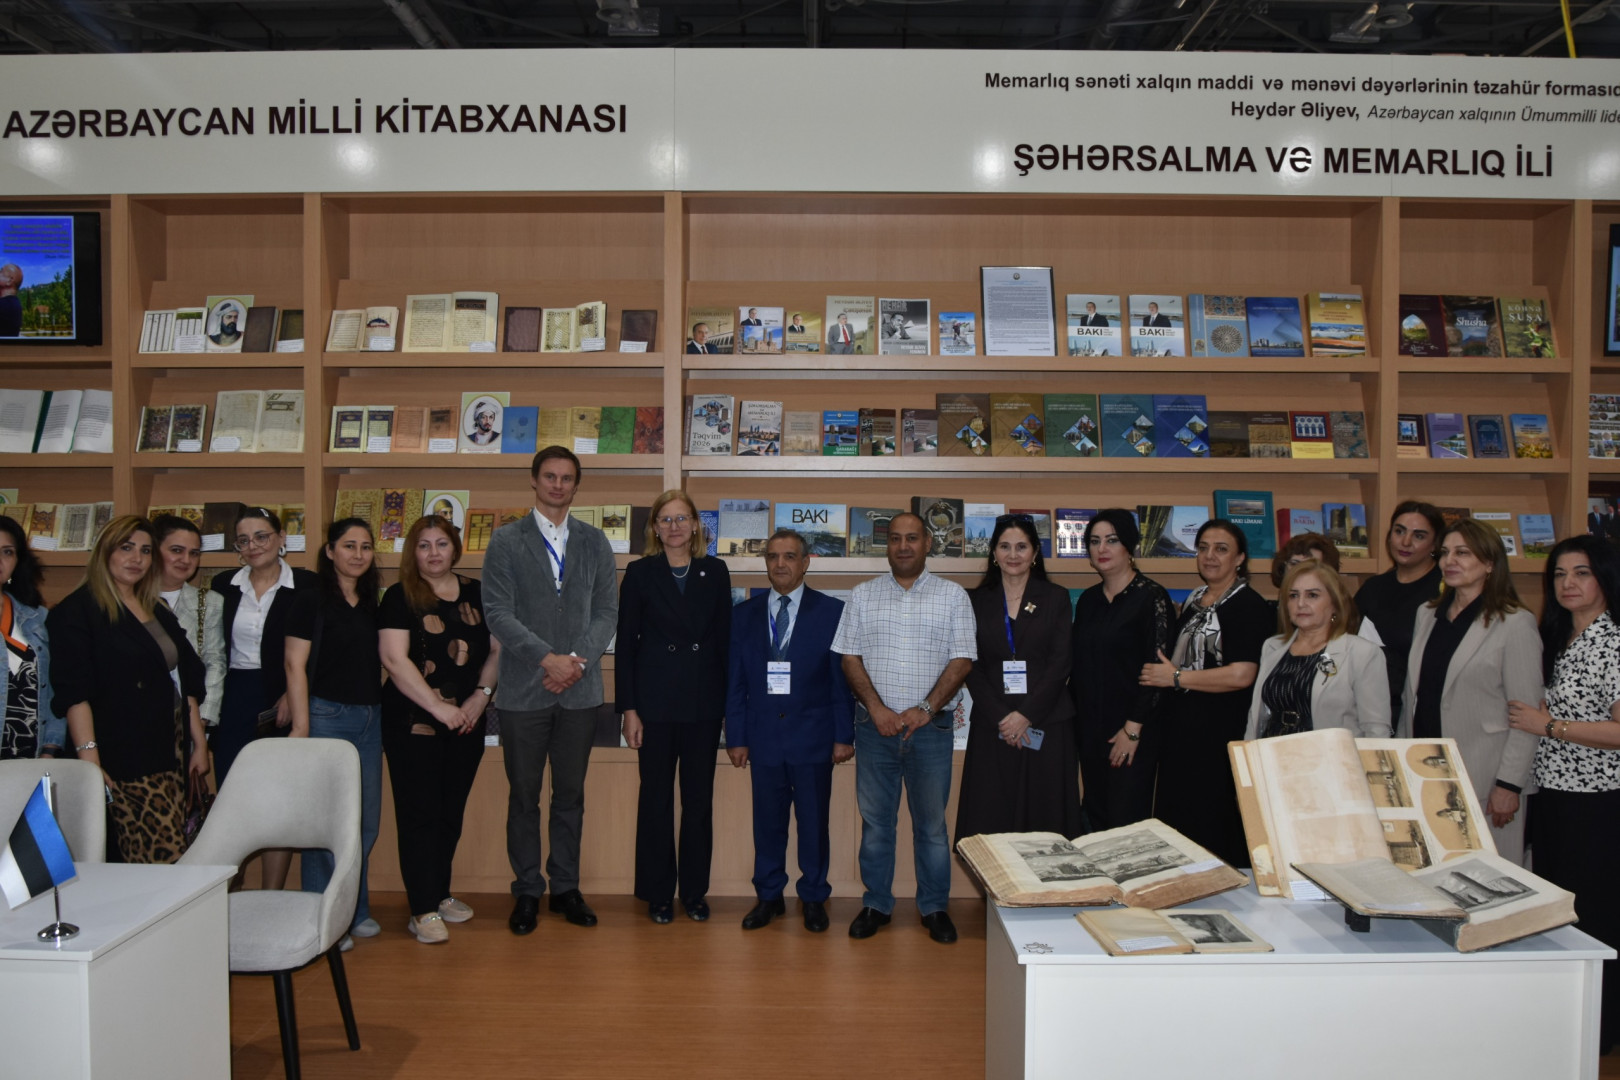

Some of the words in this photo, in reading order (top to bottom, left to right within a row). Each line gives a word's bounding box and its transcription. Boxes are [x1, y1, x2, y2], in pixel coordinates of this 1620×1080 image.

[985, 72, 1069, 92] Memarlıq
[1075, 74, 1130, 89] sənəti
[1136, 74, 1191, 93] xalqın
[1198, 75, 1254, 90] maddi
[1262, 79, 1284, 90] və
[1291, 76, 1356, 93] mənəvi
[1361, 77, 1469, 97] dəyərlərinin
[1473, 79, 1541, 96] təzahür
[2, 106, 255, 139] AZƏRBAYCAN
[268, 97, 362, 135] MİLLİ
[375, 97, 627, 134] KİTABXANASI
[1231, 101, 1297, 120] Heydər
[1301, 102, 1360, 122] Əliyev,
[1366, 105, 1455, 123] Azərbaycan
[1458, 107, 1517, 124] xalqının
[1520, 106, 1597, 123] Ümummilli
[1013, 143, 1258, 177] ŞƏHƏRSALMA
[1265, 146, 1312, 173] VƏ
[1323, 147, 1506, 178] MEMARLIQ
[1516, 143, 1553, 178] İLİ
[1456, 316, 1487, 327] Shusha
[1508, 312, 1542, 322] ŞUŞA
[1077, 328, 1103, 336] BAKI
[1139, 328, 1165, 336] BAKI
[692, 431, 721, 442] Təqvim
[792, 509, 828, 523] BAKI
